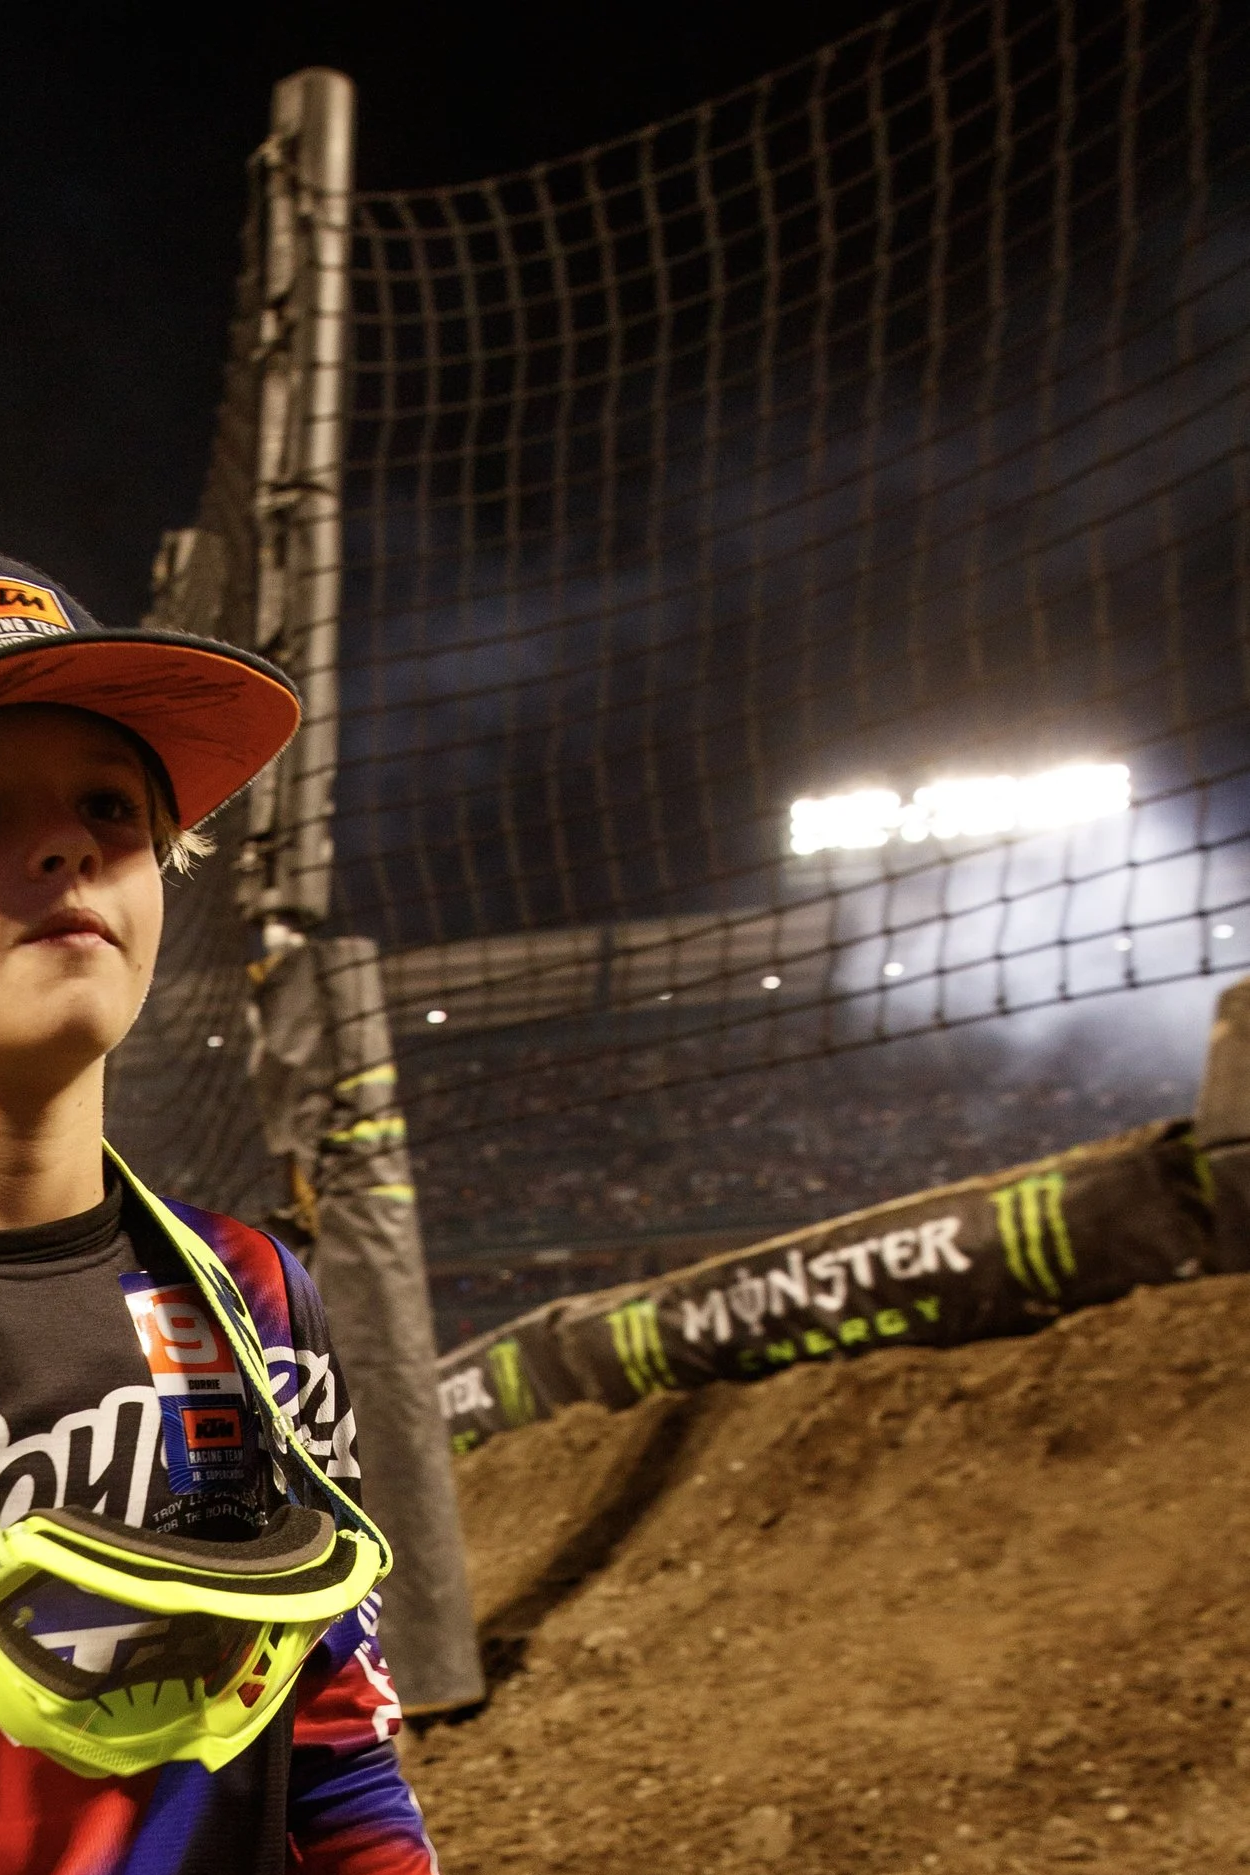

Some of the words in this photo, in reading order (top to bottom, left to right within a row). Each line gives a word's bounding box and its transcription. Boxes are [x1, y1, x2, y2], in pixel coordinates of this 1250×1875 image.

[681, 1215, 973, 1345] MONSTER
[187, 1378, 221, 1390] CURRIE
[195, 1417, 235, 1439] KTM
[189, 1450, 222, 1464] RACING
[225, 1449, 245, 1462] TEAM
[153, 1499, 183, 1523] TROY
